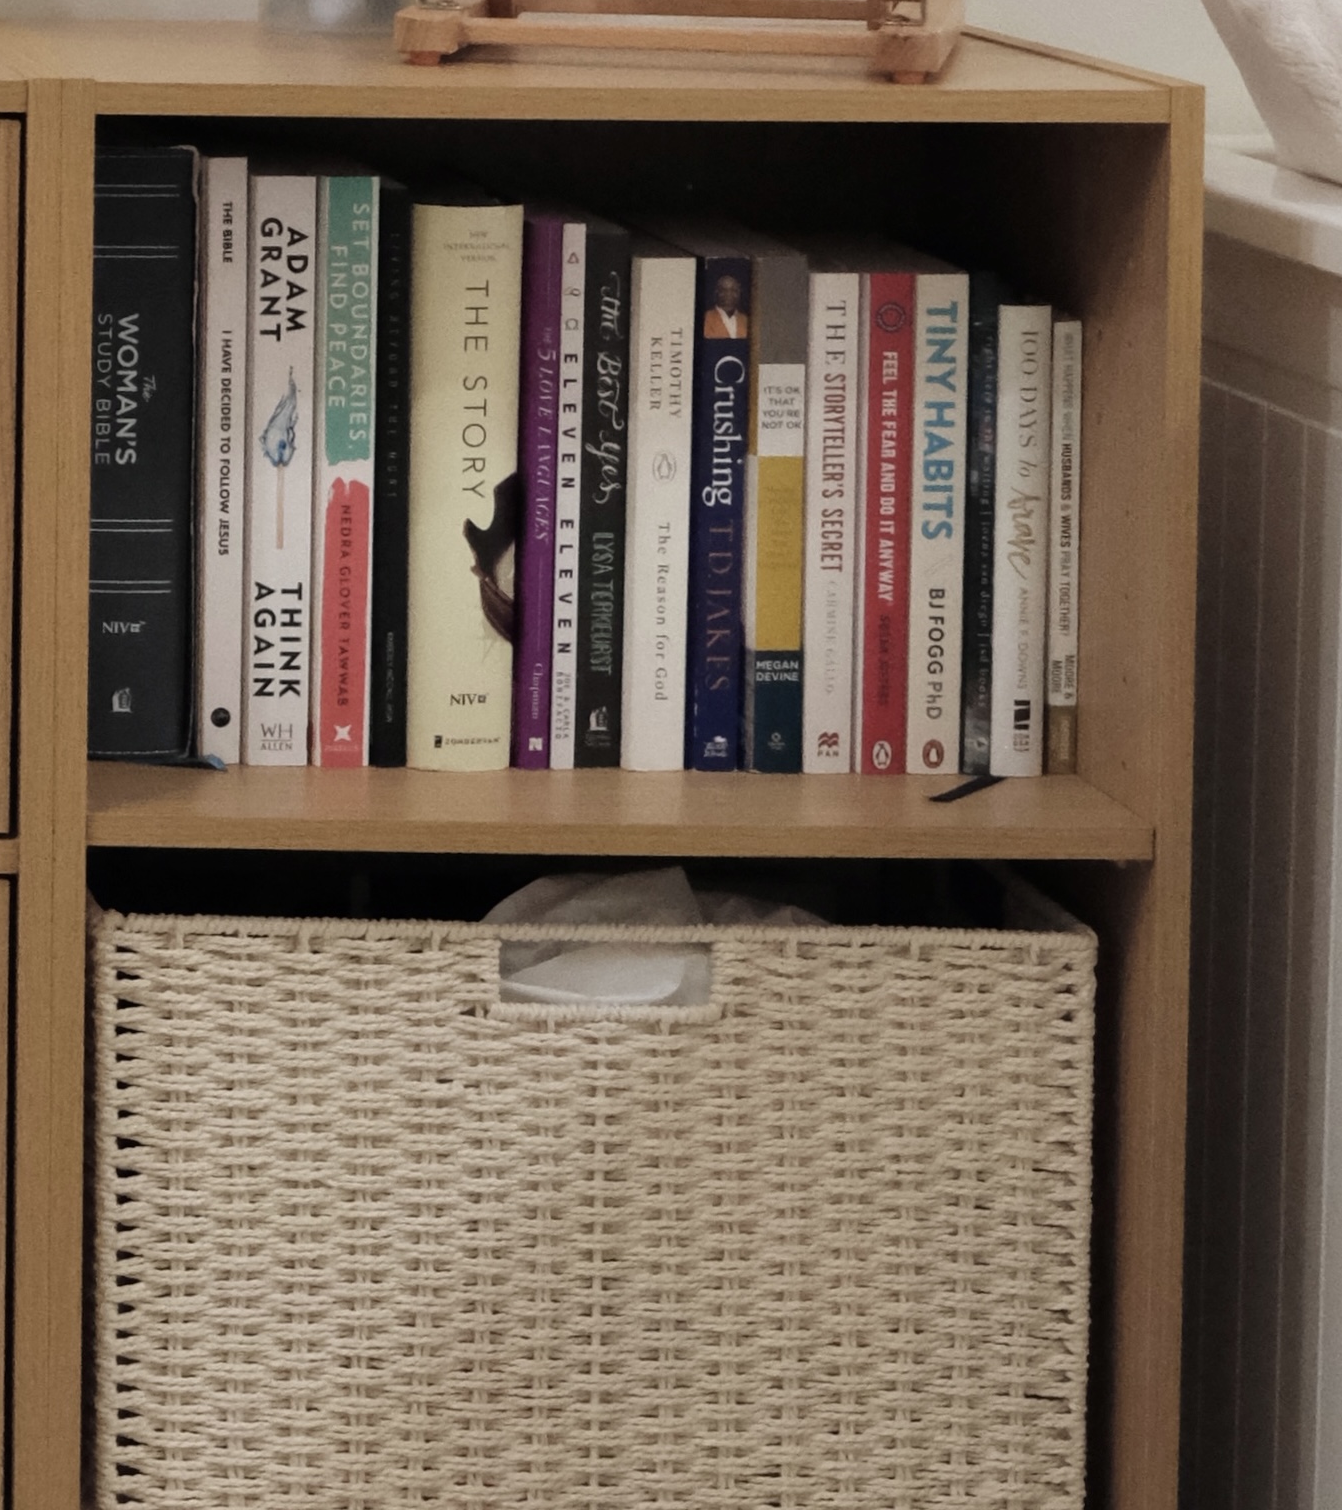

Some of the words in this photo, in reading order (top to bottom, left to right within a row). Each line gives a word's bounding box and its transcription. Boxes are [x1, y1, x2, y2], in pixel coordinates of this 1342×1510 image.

[223, 202, 233, 226] THE
[351, 203, 370, 256] SET
[222, 230, 233, 263] BIBLE
[259, 217, 282, 342] GRANT
[285, 226, 309, 332] ADAM
[329, 245, 347, 316] FIND
[463, 280, 490, 366] THE
[825, 300, 846, 364] THE
[924, 301, 958, 398] TINY
[95, 314, 113, 389] STUDY
[220, 337, 232, 374] HAVE
[328, 323, 347, 408] PEACE
[649, 336, 663, 411] KELLER
[668, 328, 683, 418] TIMOTHY
[882, 351, 899, 384] FEEL
[1020, 329, 1036, 375] 100
[115, 314, 139, 465] WOMAN'S
[142, 375, 156, 401] The
[219, 378, 232, 433] DECIDED
[763, 385, 782, 394] IT'S
[784, 385, 801, 394] OK
[768, 397, 795, 406] THAT
[881, 390, 898, 418] THE
[95, 399, 112, 465] BIBLE
[461, 376, 488, 499] STORY
[562, 353, 577, 488] ELEVEN
[703, 355, 744, 507] Crushing
[761, 420, 784, 429] NOT
[786, 420, 802, 429] OK
[821, 373, 845, 498] STORYTELLER'S
[880, 422, 897, 458] FEAR
[1019, 385, 1036, 448] DAYS
[219, 437, 231, 453] TO
[921, 401, 956, 540] HABITS
[1017, 458, 1035, 478] to
[219, 458, 231, 514] FOLLOW
[880, 462, 897, 492] AND
[339, 504, 352, 557] NEDRA
[879, 497, 896, 514] DO
[879, 518, 896, 534] IT
[1006, 486, 1042, 580] brave
[218, 519, 230, 556] JESUS
[592, 532, 615, 574] LYSA
[657, 522, 670, 558] The
[819, 509, 844, 572] SECRET
[338, 563, 352, 630] GLOVER
[557, 519, 574, 654] ELEVEN
[656, 563, 669, 624] Reason
[877, 539, 895, 601] ANYWAY
[926, 588, 945, 609] BJ
[253, 582, 276, 698] AGAIN
[278, 582, 302, 698] THINK
[589, 581, 614, 675] TERKEURST
[655, 634, 669, 658] for
[926, 614, 945, 675] FOGG
[337, 637, 350, 707] TAWWAB
[529, 663, 543, 719] Chapman
[654, 667, 668, 701] God
[756, 661, 799, 671] MEGAN
[756, 672, 799, 682] DEVINE
[1051, 660, 1061, 693] MOORE
[926, 681, 943, 720] PhD
[260, 723, 293, 739] WH
[260, 742, 293, 750] ALLEN
[817, 750, 839, 758] PAN
